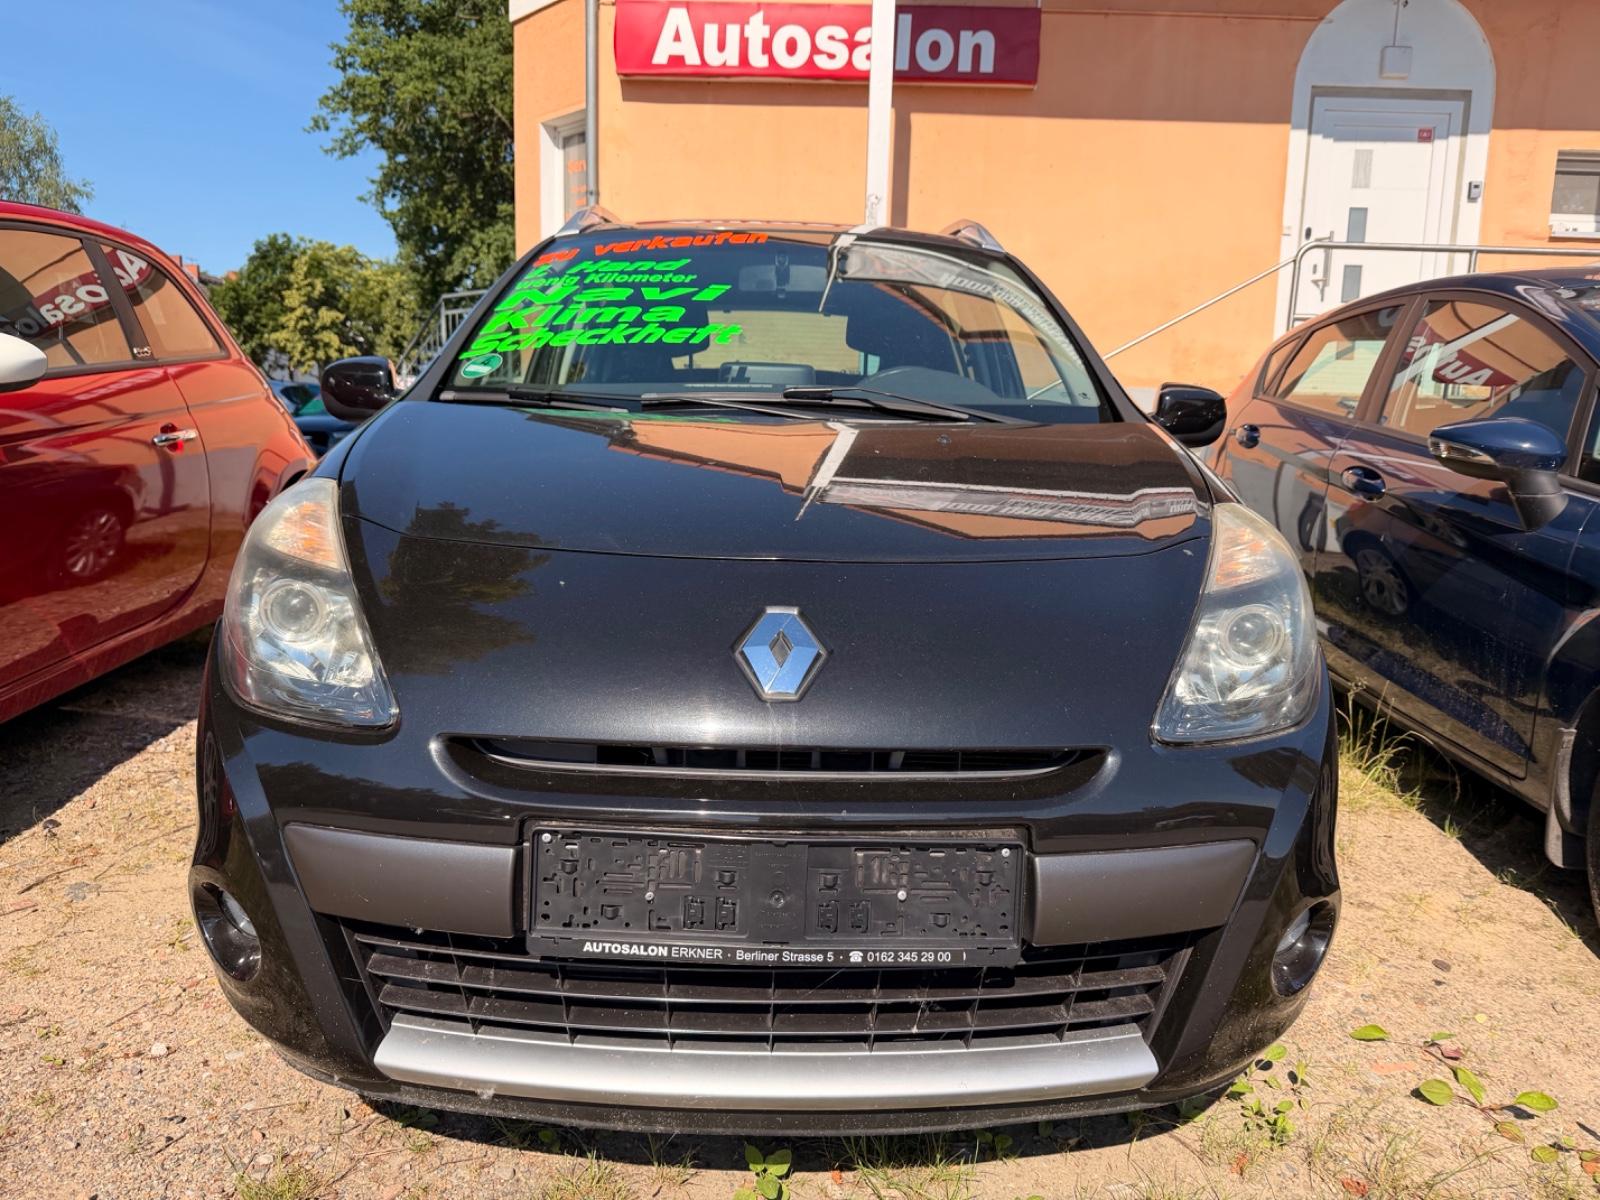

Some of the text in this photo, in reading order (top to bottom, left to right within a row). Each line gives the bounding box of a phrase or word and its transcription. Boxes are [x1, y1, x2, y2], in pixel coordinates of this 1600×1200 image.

[651, 6, 996, 74] Autosalon
[594, 231, 769, 256] verkaufen
[565, 258, 692, 273] Hand
[583, 272, 698, 284] Kilometer
[494, 283, 732, 312] Navi
[479, 303, 686, 336] Klima
[458, 323, 743, 360] Scheckheft
[582, 941, 952, 962] AUTOSALON ERKNER Berliner Strasse 5 0162 345 29 00
